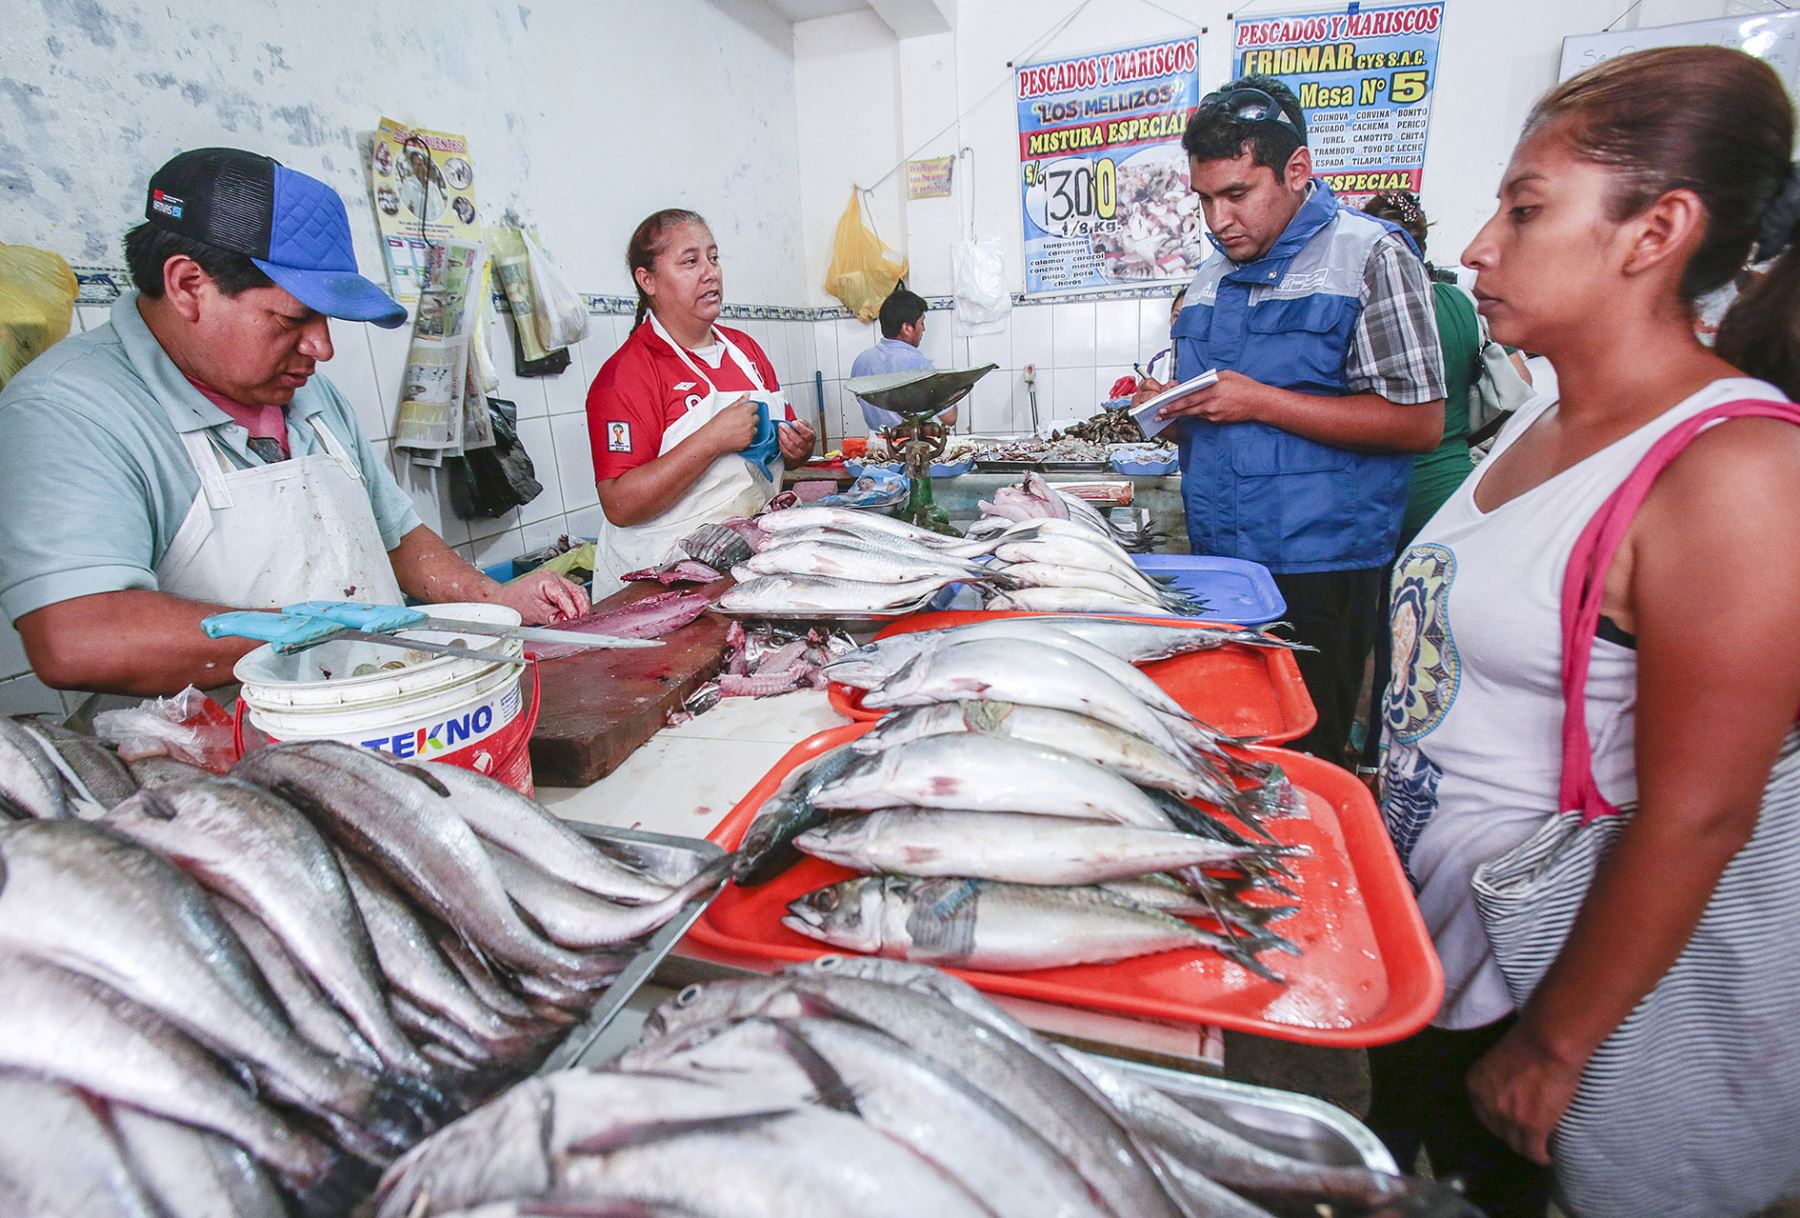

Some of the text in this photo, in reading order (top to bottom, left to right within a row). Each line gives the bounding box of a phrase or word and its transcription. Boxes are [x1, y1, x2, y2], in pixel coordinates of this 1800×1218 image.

[1237, 7, 1441, 46] PESCADOS Y MARISCOS
[1242, 43, 1427, 77] FRIOMAR CYS S.A.C.
[1019, 41, 1196, 97] PESCADOS Y MARISCOS
[1300, 82, 1354, 109] Mesa
[1391, 71, 1429, 103] 5
[1313, 107, 1428, 122] COJINOVA CORVINA BONITO
[1352, 121, 1389, 132] CACHEMA
[1396, 119, 1426, 129] PERICO
[1028, 110, 1188, 156] MISTURA ESPECIAL
[1322, 131, 1425, 145] JUREL CAMOTITO CHITA
[1314, 143, 1423, 156] TRAMBOYO TOYO DE LECHE
[1315, 155, 1422, 168] ESPADA TILAPIA TRUCHA
[1043, 239, 1090, 249] langostino
[1030, 253, 1104, 266] calamar caracol
[1029, 261, 1106, 274] conchas machas
[1053, 279, 1082, 287] choros
